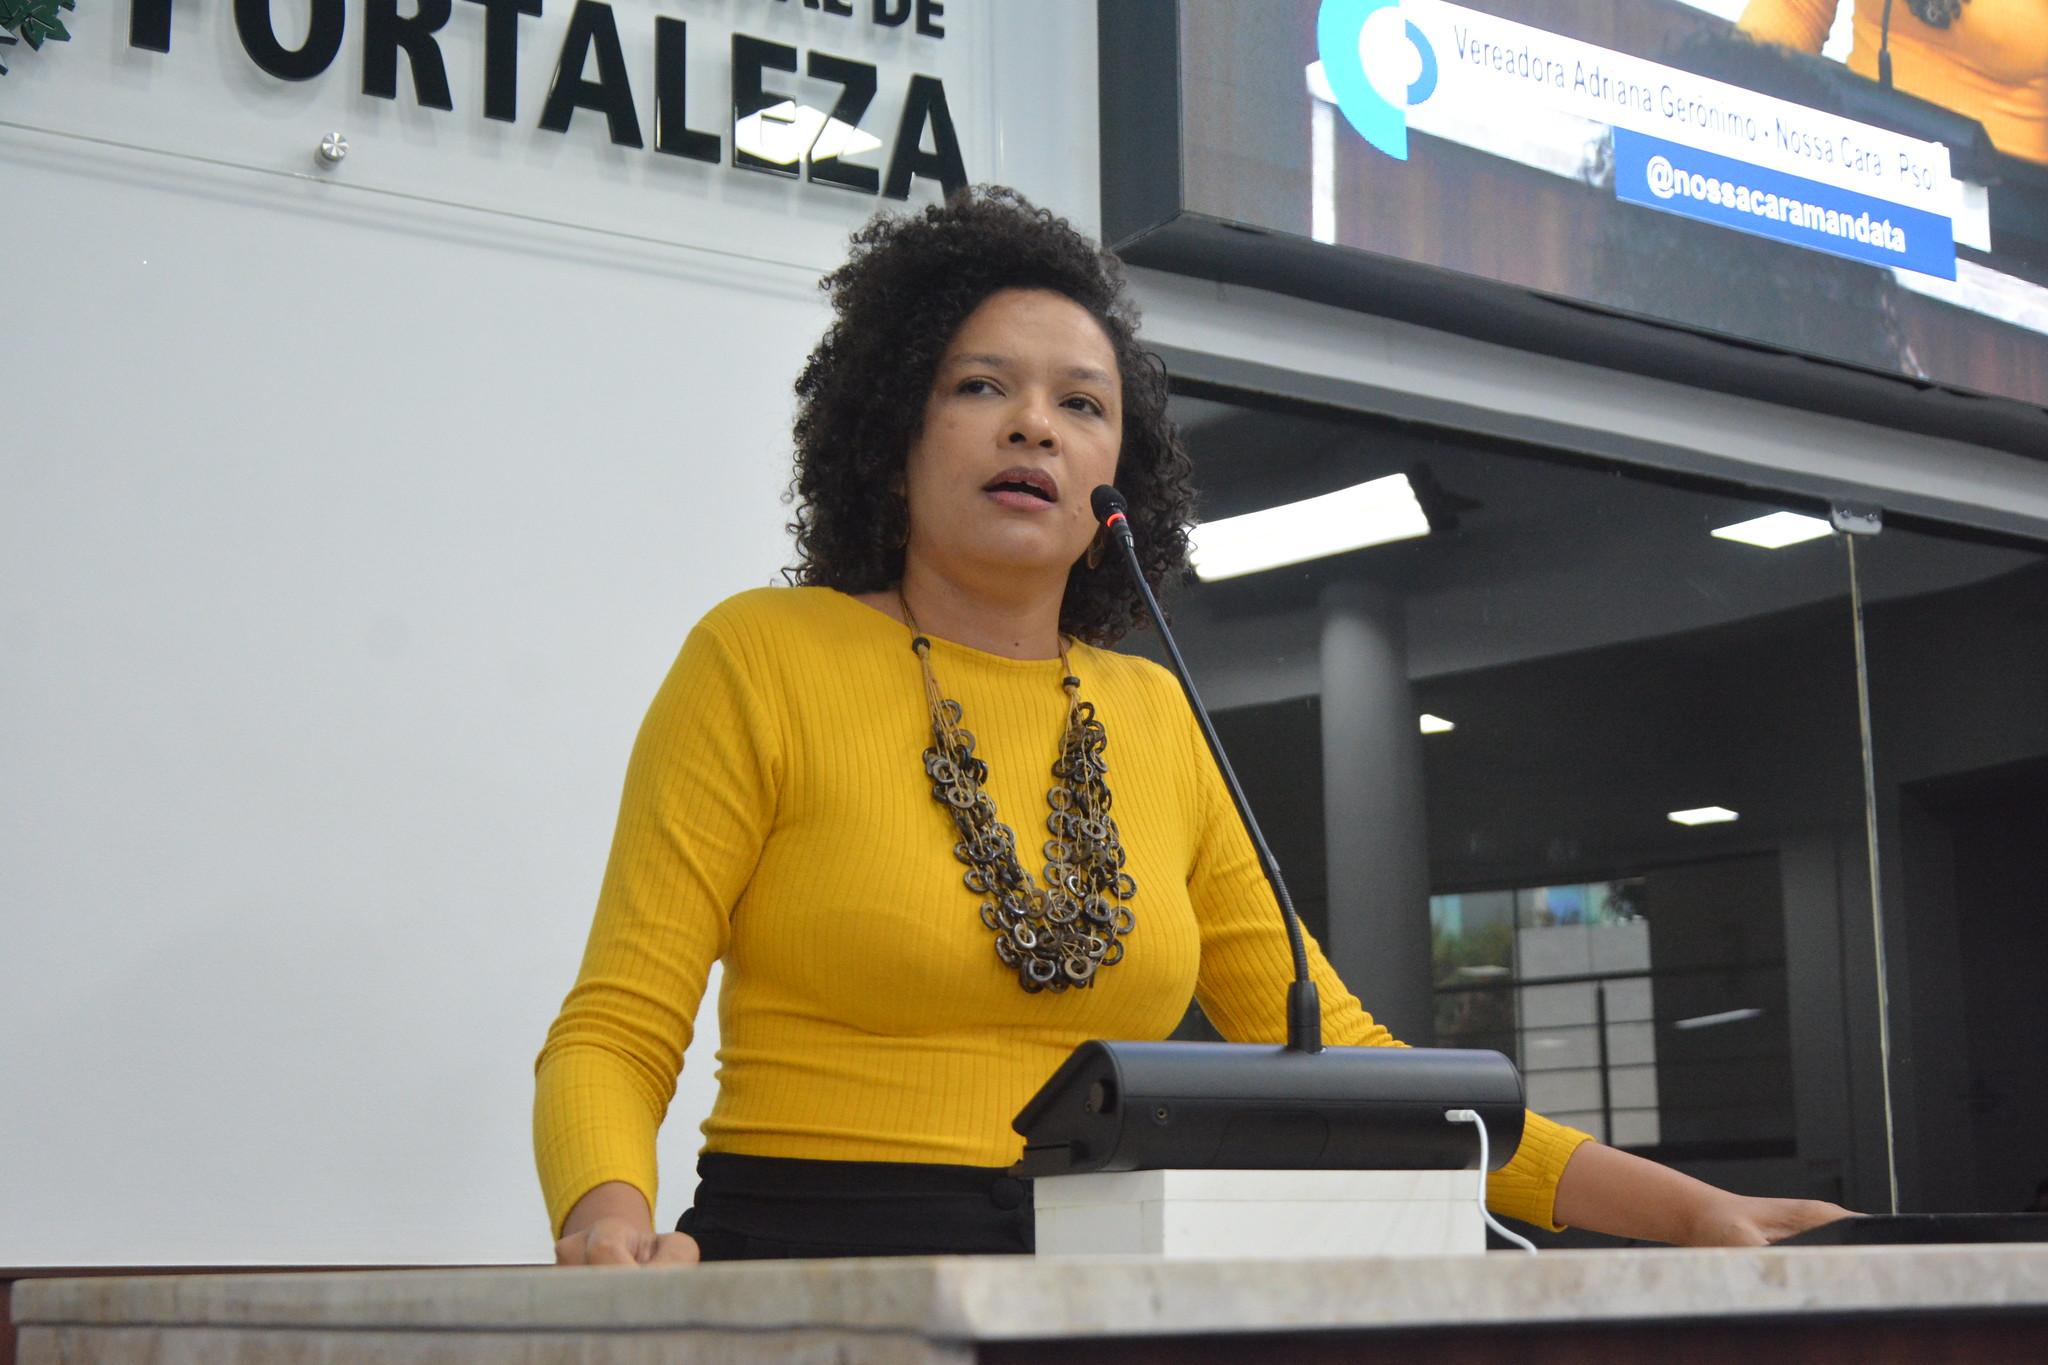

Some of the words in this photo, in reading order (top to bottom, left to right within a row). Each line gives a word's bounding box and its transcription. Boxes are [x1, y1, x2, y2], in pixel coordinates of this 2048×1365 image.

[1454, 24, 1565, 88] Vereadora
[1573, 60, 1652, 112] Adriana
[1775, 117, 1835, 164] Nossa
[1840, 136, 1882, 177] Cara
[1646, 155, 1906, 253] @nossacaramandata
